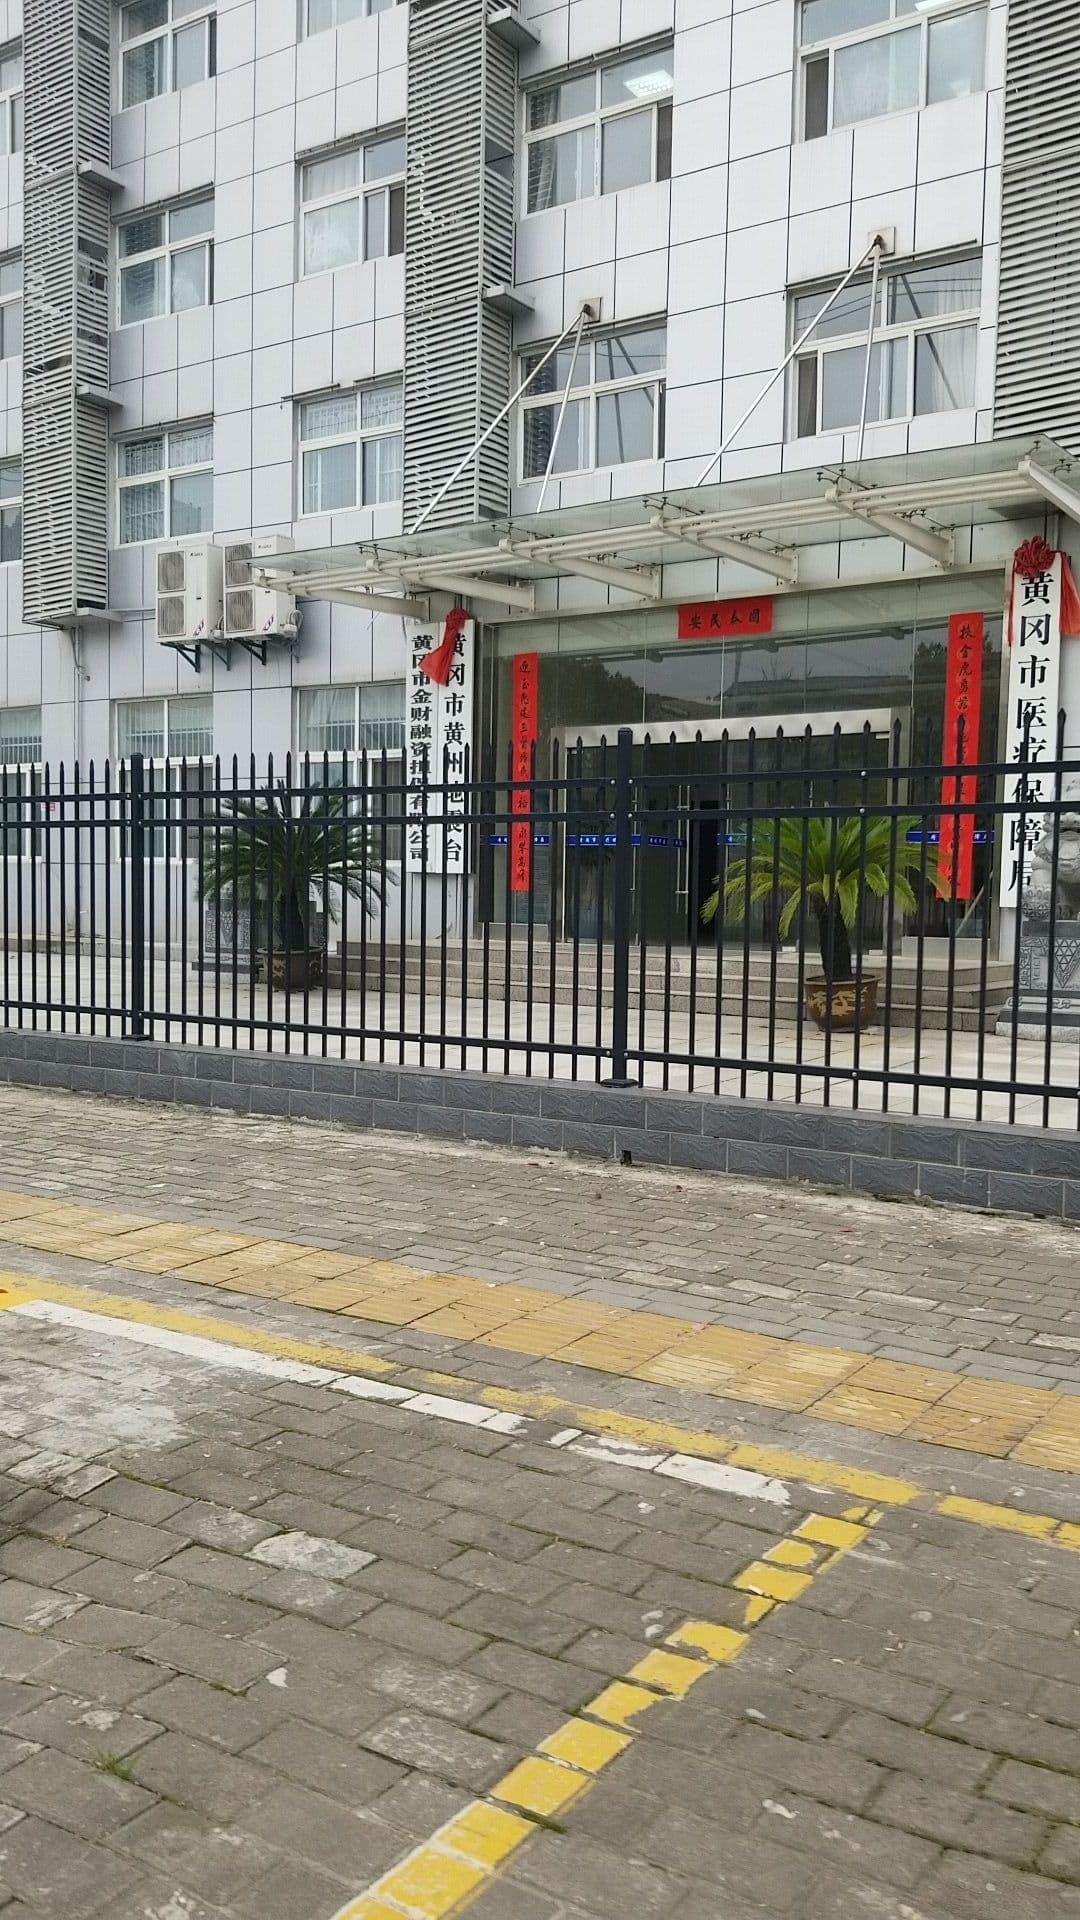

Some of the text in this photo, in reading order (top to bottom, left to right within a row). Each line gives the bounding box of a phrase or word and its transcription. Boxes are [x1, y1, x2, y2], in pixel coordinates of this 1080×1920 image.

[1009, 572, 1055, 892] 黄冈市医疗保障局
